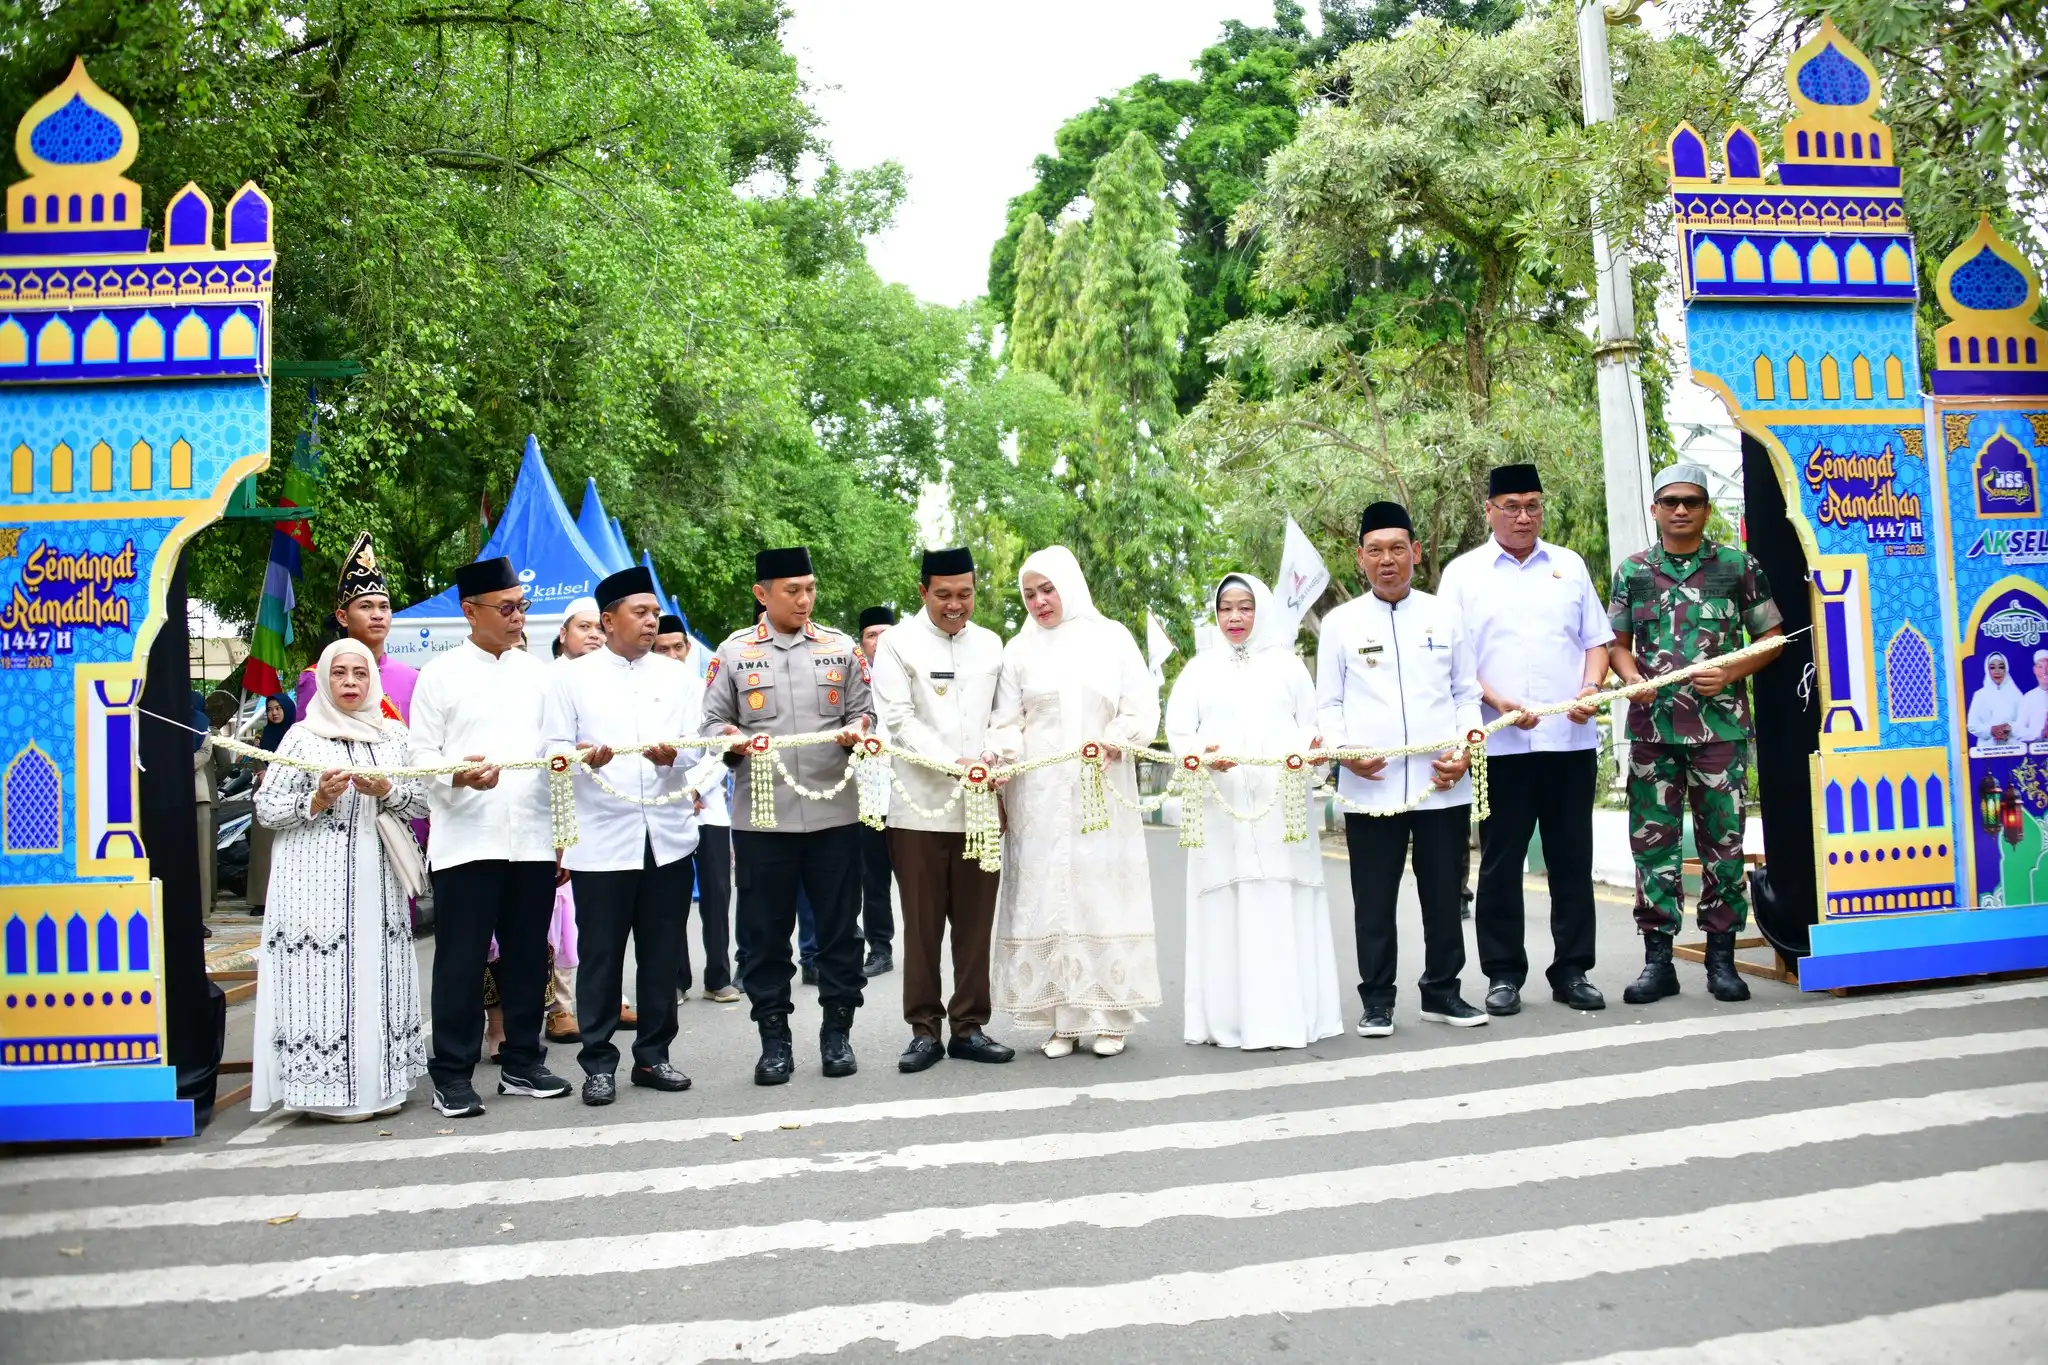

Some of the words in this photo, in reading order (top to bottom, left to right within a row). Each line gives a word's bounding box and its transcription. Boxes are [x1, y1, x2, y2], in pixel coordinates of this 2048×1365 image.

[1805, 443, 1896, 490] Semangat
[1995, 473, 2023, 488] HSS
[1819, 479, 1921, 525] Ramadhan
[1868, 522, 1905, 538] 1447
[1910, 522, 1922, 537] H
[23, 540, 136, 592] Semangat
[533, 580, 589, 597] kalsel
[0, 583, 129, 632] Ramadhan
[3, 632, 50, 650] 1447
[57, 631, 71, 648] H
[386, 642, 416, 653] bank
[28, 656, 52, 669] 2026
[737, 661, 769, 670] AWAL
[815, 657, 847, 666] POLRI
